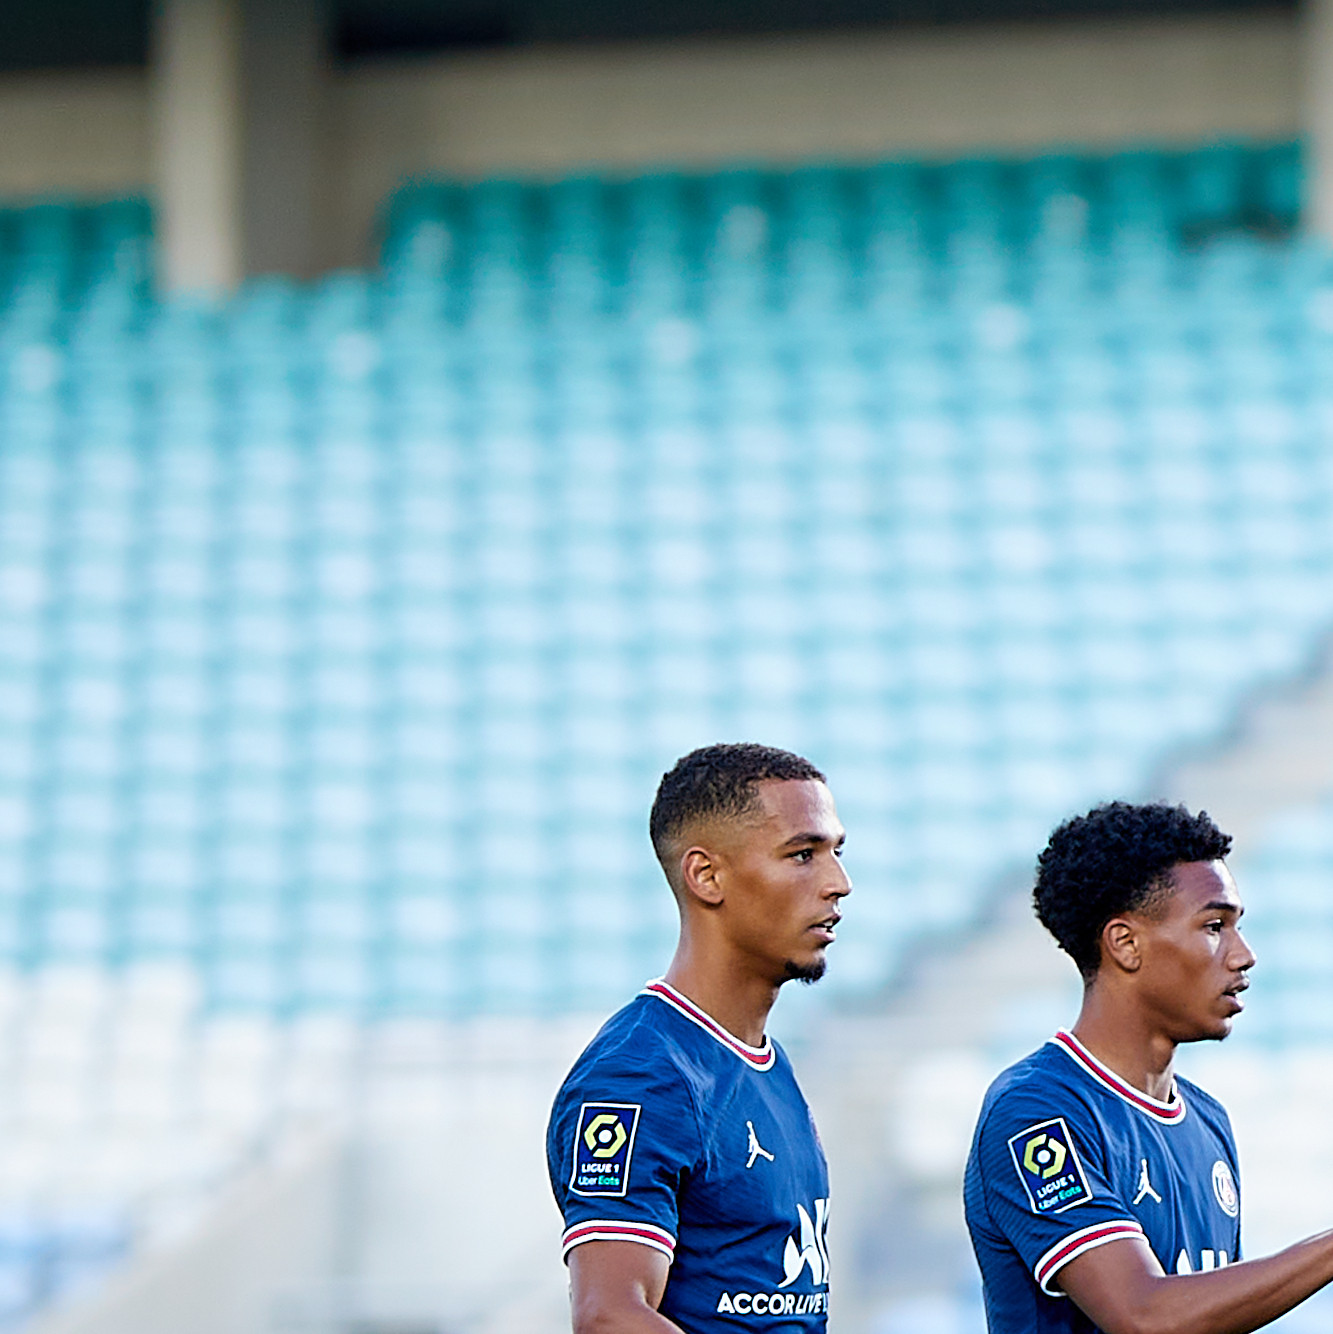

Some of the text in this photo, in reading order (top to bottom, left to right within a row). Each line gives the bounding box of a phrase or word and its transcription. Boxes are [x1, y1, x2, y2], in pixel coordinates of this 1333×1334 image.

[581, 1163, 620, 1174] LIGUE 1
[1036, 1176, 1068, 1198] LIGUE
[717, 1292, 795, 1315] ACCOR
[795, 1292, 822, 1315] LIVE
